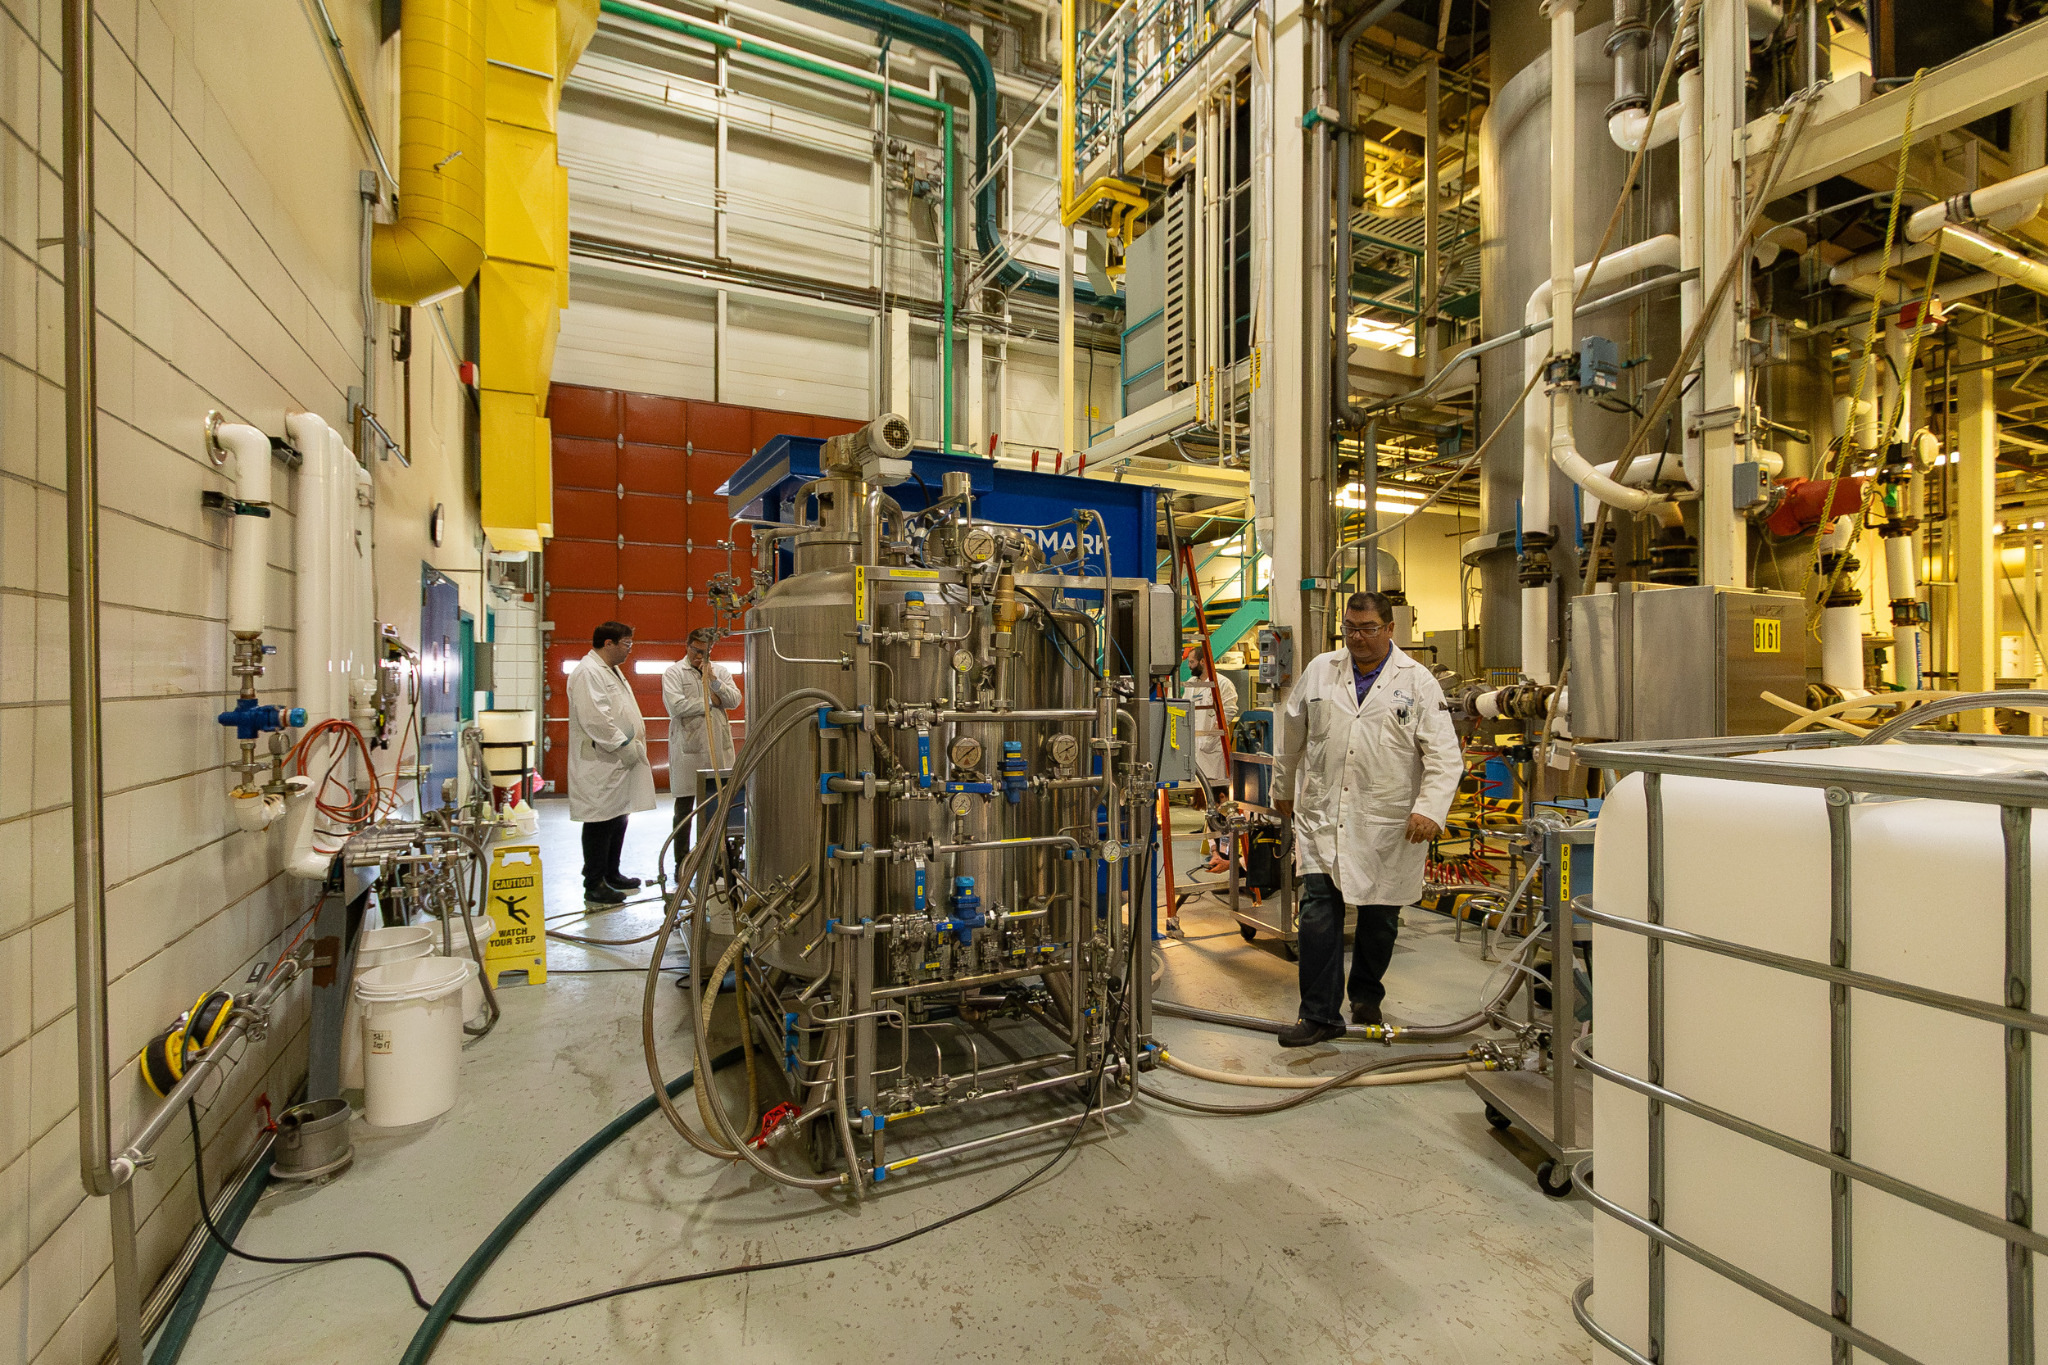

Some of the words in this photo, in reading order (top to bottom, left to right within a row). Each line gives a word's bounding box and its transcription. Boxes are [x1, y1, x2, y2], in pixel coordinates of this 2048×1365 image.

[1755, 622, 1779, 650] 8161
[494, 877, 533, 890] CAUTION
[498, 927, 528, 938] WATCH
[490, 937, 513, 948] YOUR
[515, 935, 536, 945] STEP
